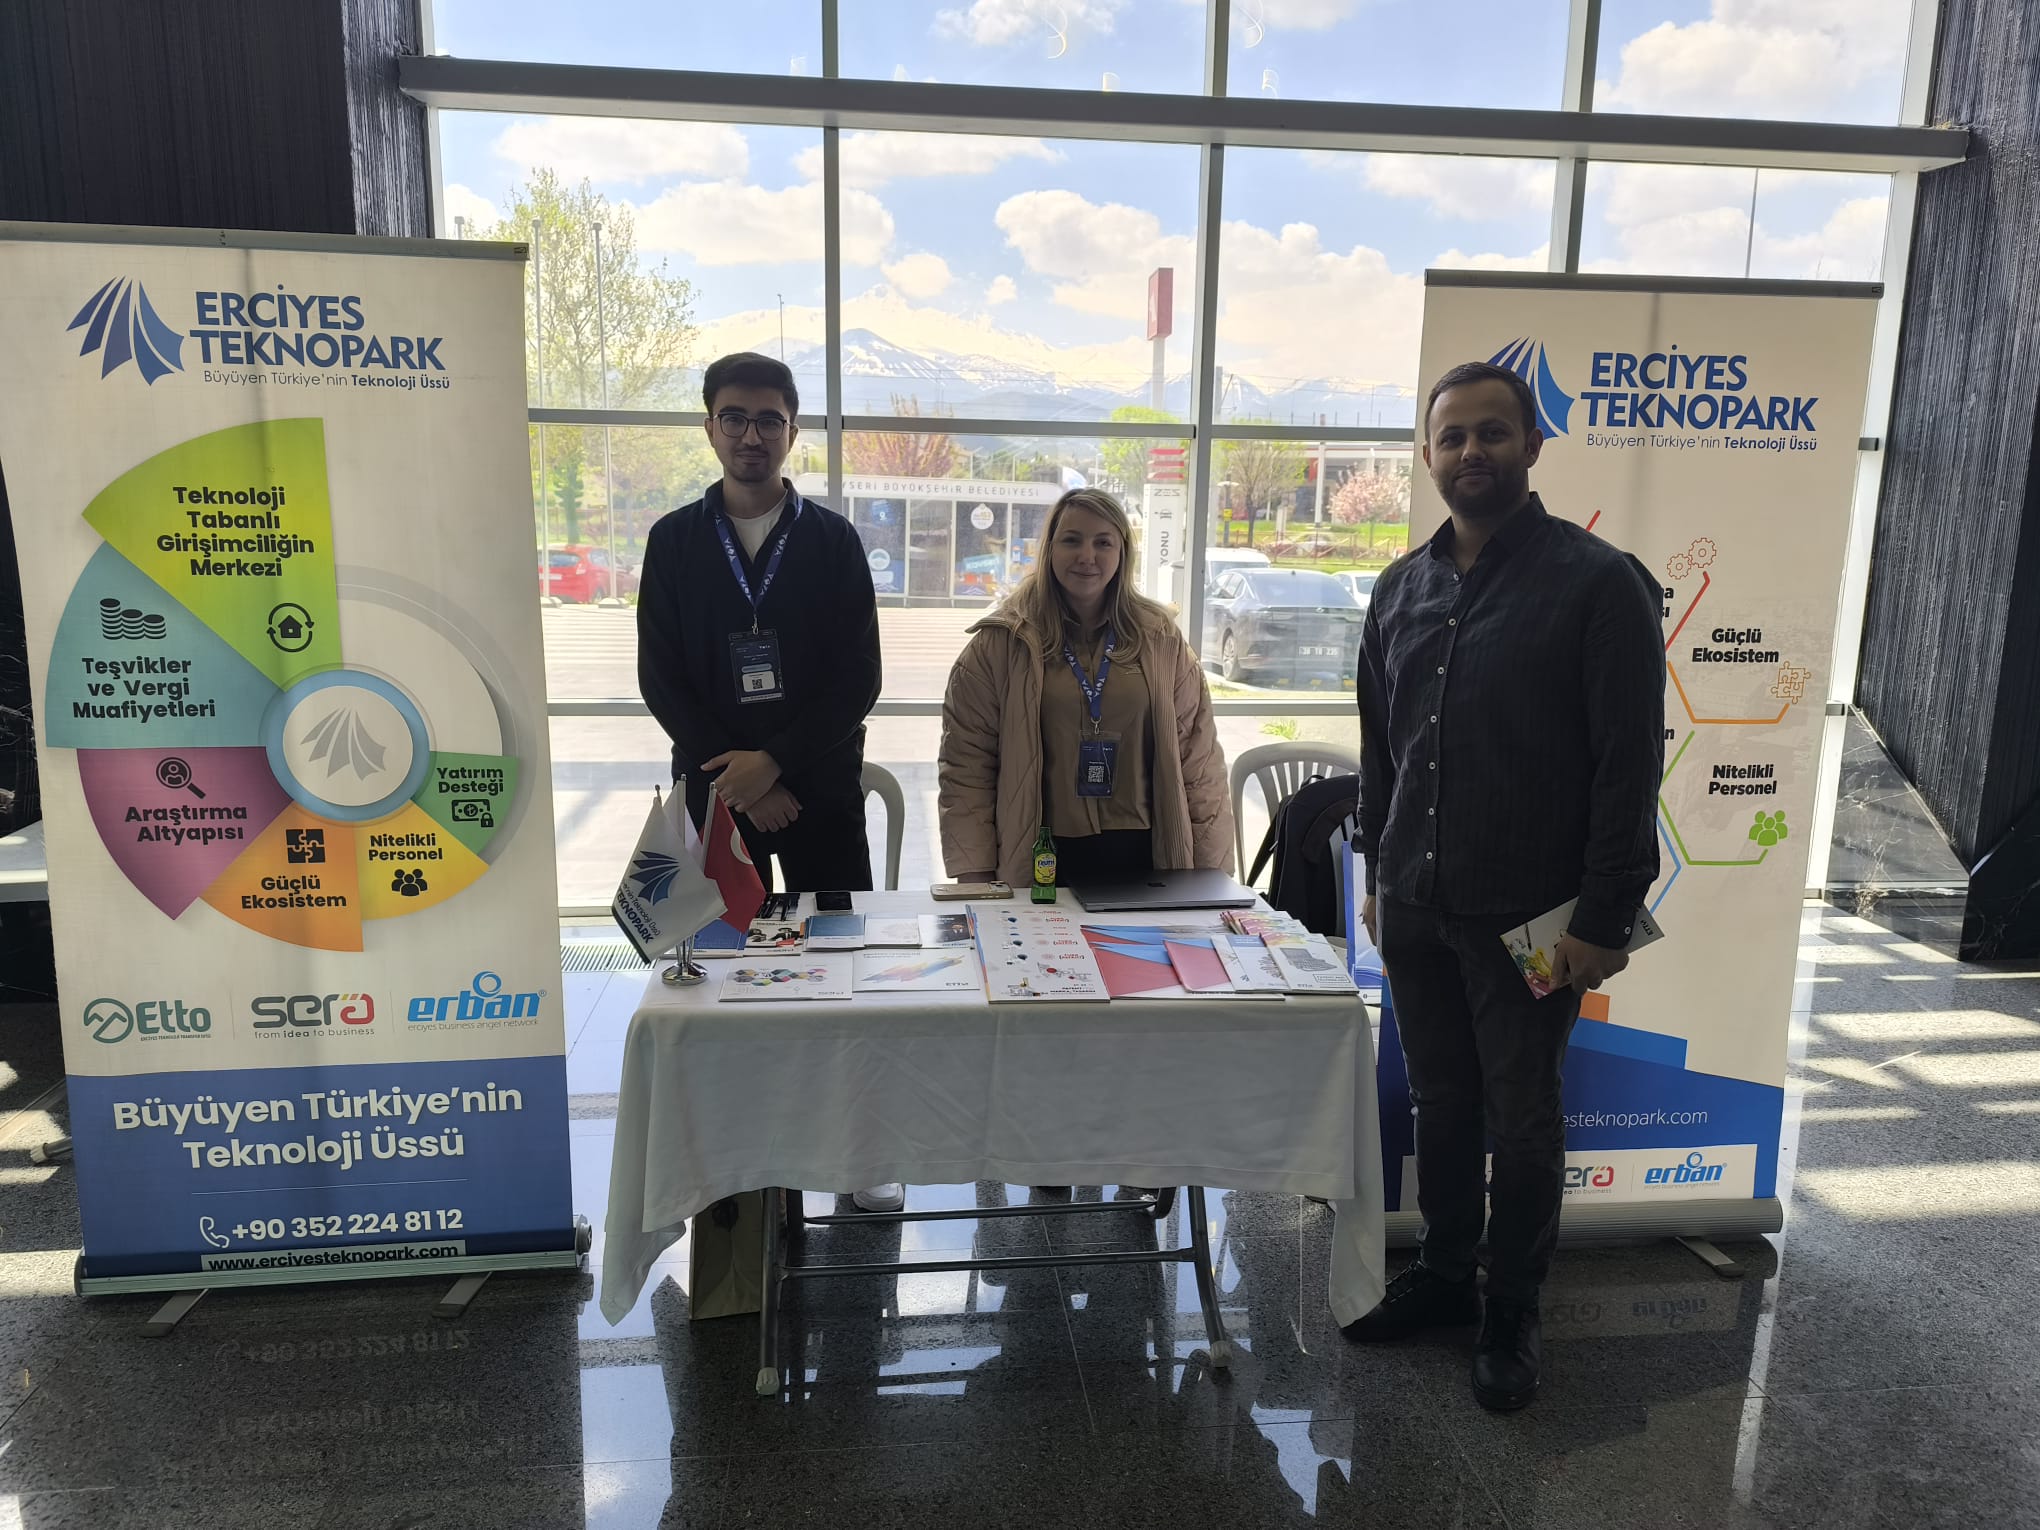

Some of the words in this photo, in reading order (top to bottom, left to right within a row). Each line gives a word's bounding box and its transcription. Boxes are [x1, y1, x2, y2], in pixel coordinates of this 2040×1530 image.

[195, 283, 364, 331] ERCİYES
[190, 330, 447, 371] TEKNOPARK
[1590, 344, 1747, 391] ERCİYES
[204, 370, 268, 386] Büyüyen
[271, 371, 348, 388] Türkiye'nin
[351, 373, 416, 389] Teknoloji
[420, 373, 450, 389] Üssü
[1581, 391, 1819, 432] TEKNOPARK
[1587, 433, 1646, 450] Büyüyen
[1649, 434, 1721, 451] Türkiye'nin
[1723, 436, 1786, 453] Teknoloji
[1789, 435, 1818, 451] Üssü
[173, 487, 286, 510] Teknoloji
[186, 510, 281, 530] Tabanlı
[157, 534, 315, 558] Girişimciliğin
[1160, 530, 1170, 565] YONU
[190, 558, 283, 577] Merkezi
[1711, 628, 1763, 646] Güçlü
[1691, 647, 1780, 664] Ekosistem
[82, 656, 192, 681] Teşvikler
[87, 682, 116, 697] ve
[123, 678, 190, 702] Vergi
[72, 700, 216, 724] Muafiyetleri
[436, 766, 505, 782] Yatırım
[1712, 763, 1775, 779] Nitelikli
[437, 779, 505, 797] Desteği
[1708, 780, 1778, 796] Personel
[124, 803, 248, 827] Araştırma
[136, 823, 245, 847] Altyapısı
[369, 832, 437, 848] Nitelikli
[367, 846, 444, 863] Personel
[260, 874, 321, 897] Güçlü
[240, 893, 348, 911] Ekosistem
[135, 999, 212, 1035] Etto
[438, 1020, 475, 1031] business
[476, 1020, 502, 1030] angel
[503, 1018, 539, 1028] network
[254, 1030, 281, 1039] from
[283, 1029, 310, 1039] idea
[313, 1028, 325, 1038] to
[328, 1027, 375, 1037] business
[113, 1095, 296, 1136] Büyüyen
[301, 1081, 523, 1126] Türkiye'nin
[1563, 1108, 1707, 1128] esteknopark.com
[182, 1130, 363, 1171] Teknoloji
[371, 1126, 465, 1159] Üssü
[1564, 1165, 1615, 1188] era
[232, 1218, 285, 1240] +90
[291, 1215, 343, 1238] 352
[348, 1212, 399, 1234] 224
[404, 1210, 431, 1231] 81
[436, 1208, 464, 1230] 12
[208, 1244, 459, 1272] www.erciyesteknopark.com
